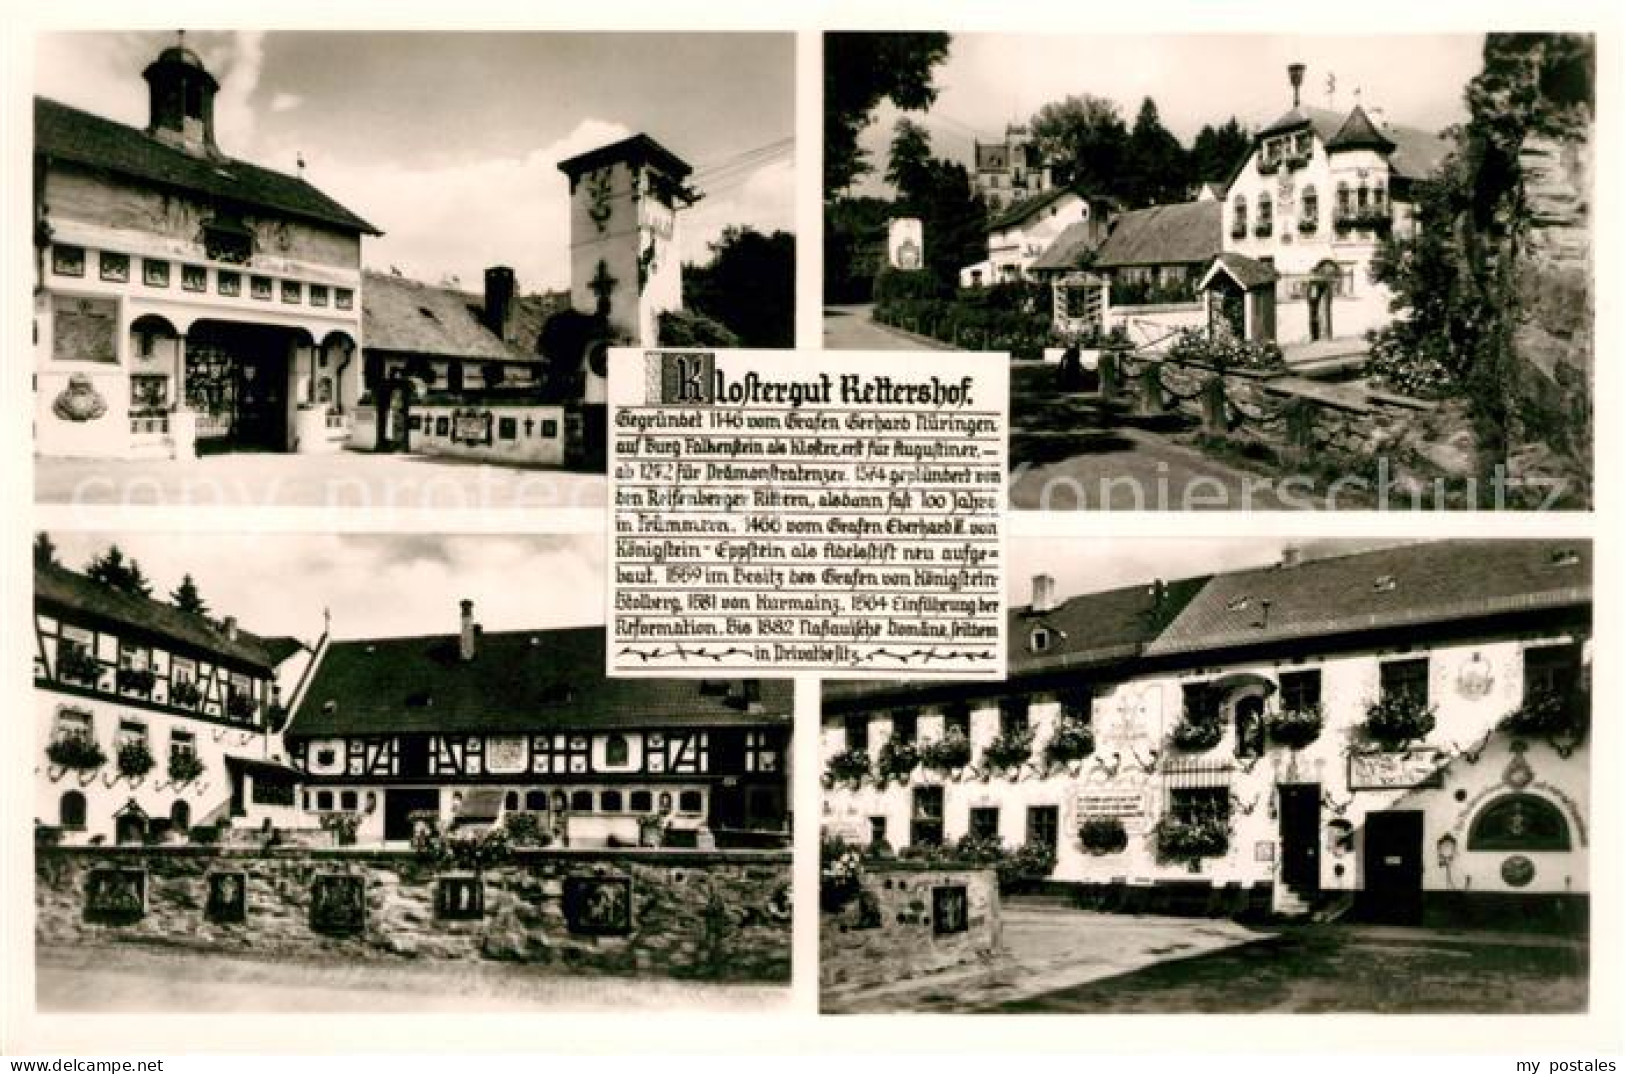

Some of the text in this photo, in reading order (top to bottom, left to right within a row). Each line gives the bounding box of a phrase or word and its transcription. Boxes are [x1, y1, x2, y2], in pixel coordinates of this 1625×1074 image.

[675, 357, 973, 408] Klostergut Rettershof.
[615, 436, 642, 458] auf
[644, 437, 681, 458] Burg
[685, 438, 766, 458] Falkenstein
[615, 512, 633, 532] in
[825, 517, 882, 539] Grafen
[713, 540, 785, 563] Eppstein
[901, 547, 935, 561] neu
[822, 568, 878, 590] Grafen
[753, 642, 771, 661] in
